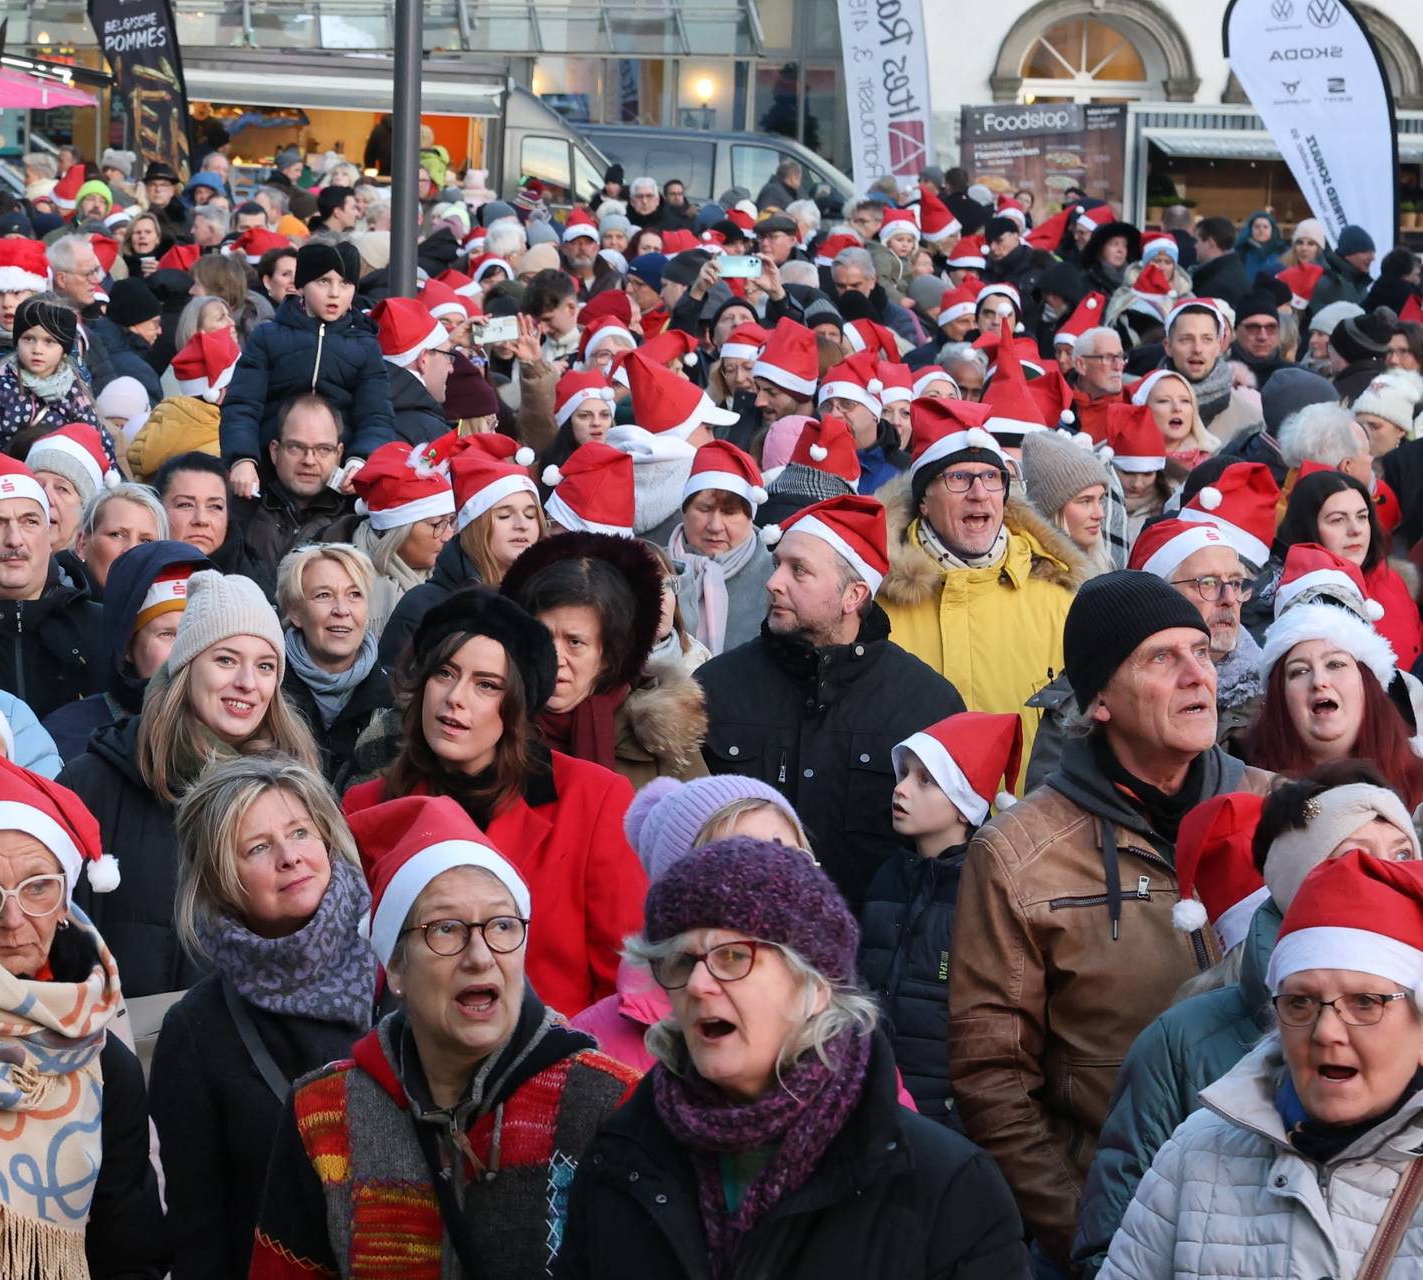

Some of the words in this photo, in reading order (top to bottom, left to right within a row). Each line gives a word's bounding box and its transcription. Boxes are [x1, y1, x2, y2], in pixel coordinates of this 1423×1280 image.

[104, 12, 158, 33] BELGISCHE
[104, 26, 167, 52] POMMES
[983, 110, 1069, 132] Foodstop
